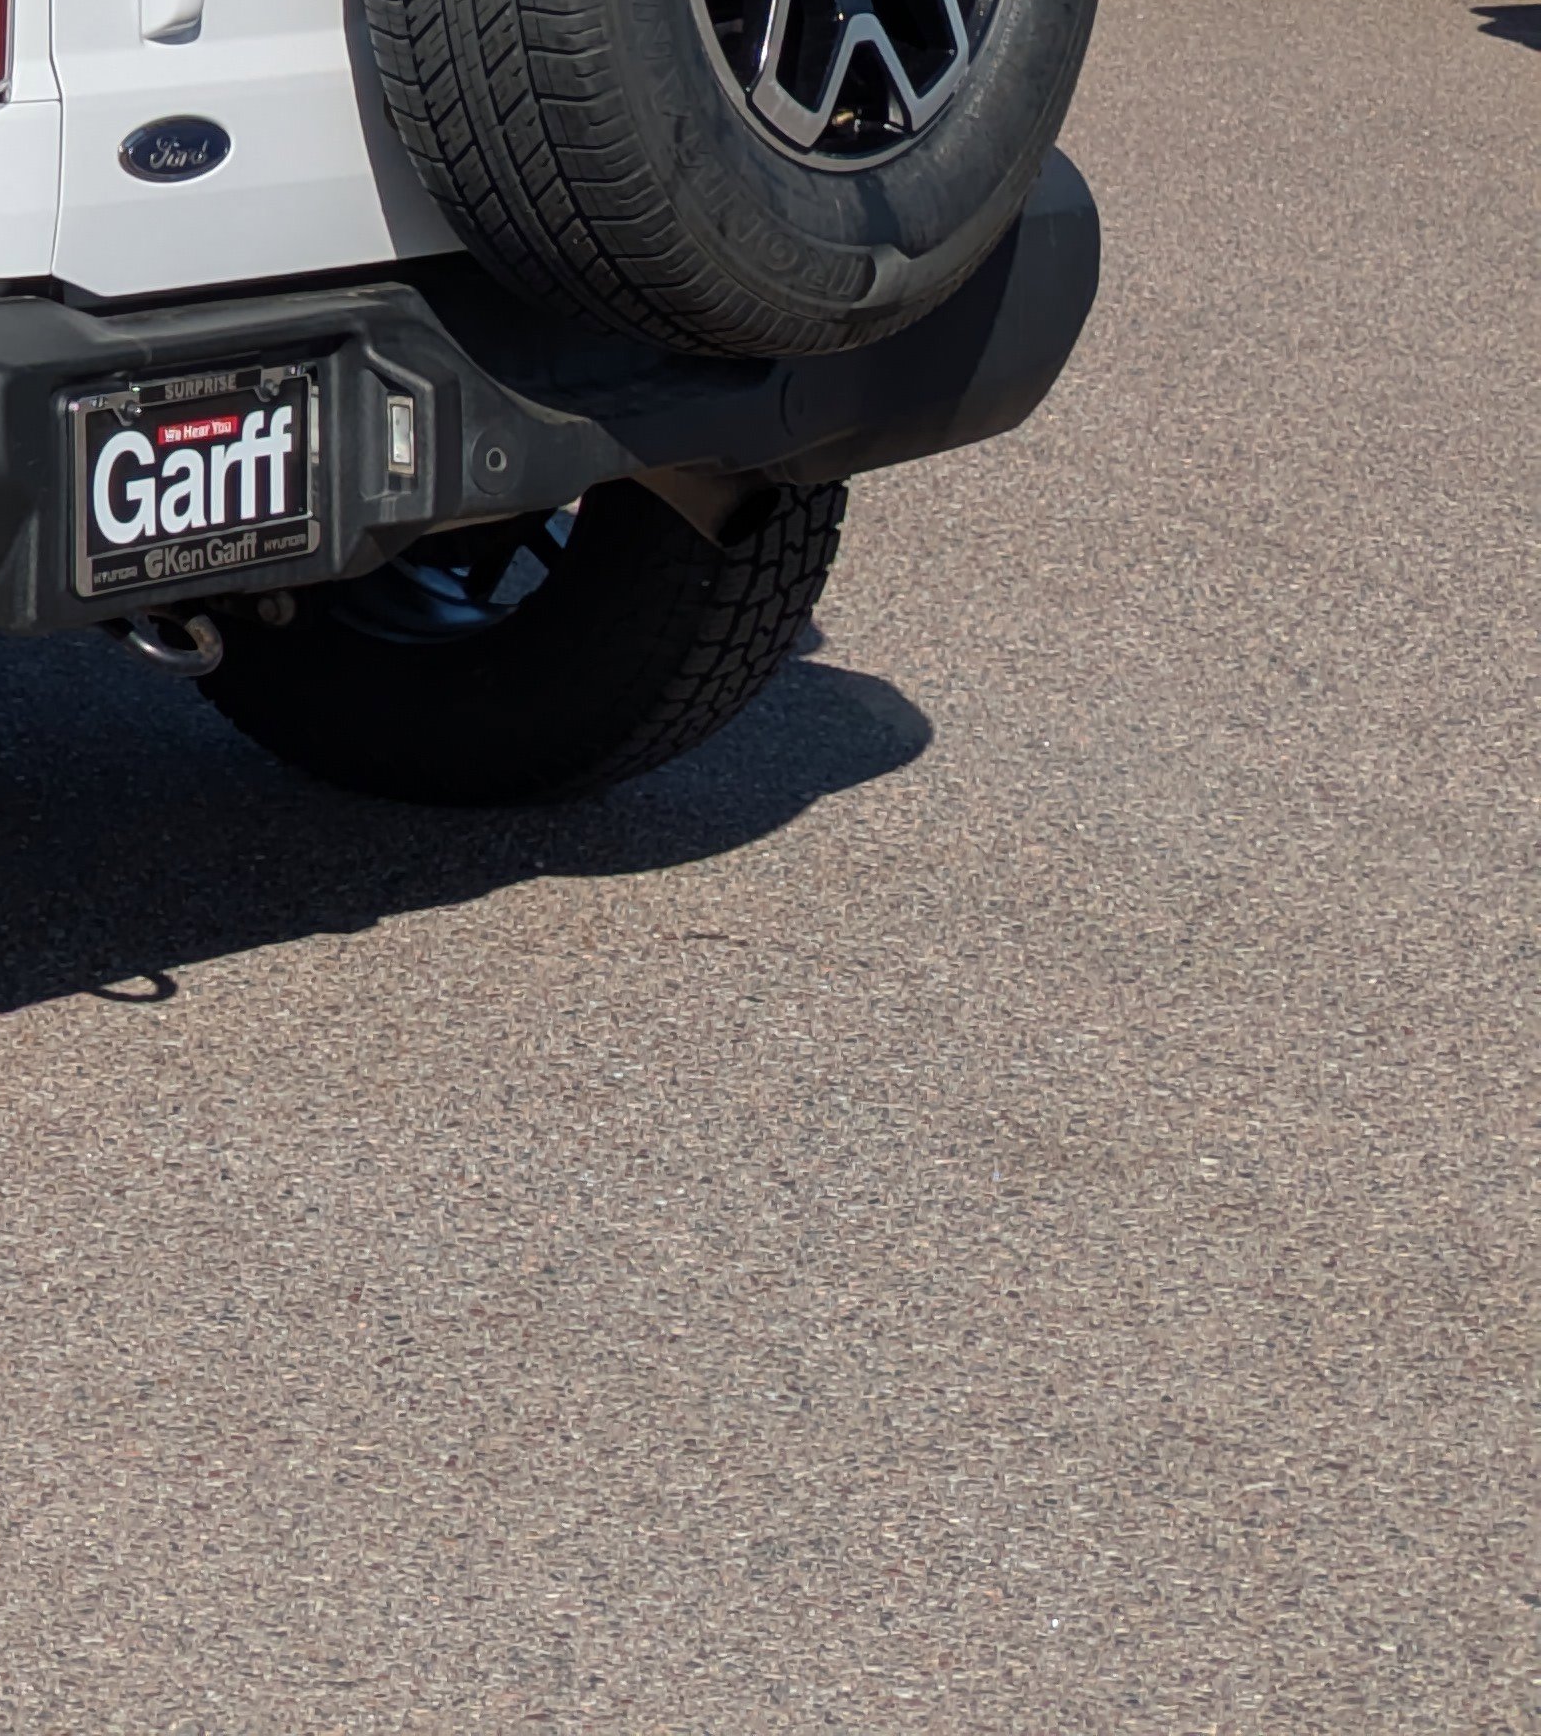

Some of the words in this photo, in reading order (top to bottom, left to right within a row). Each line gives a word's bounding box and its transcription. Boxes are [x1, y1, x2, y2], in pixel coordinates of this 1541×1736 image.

[149, 137, 208, 169] Ford
[164, 373, 237, 400] SURPRISE
[93, 405, 293, 544] Garff
[207, 531, 257, 566] Garff
